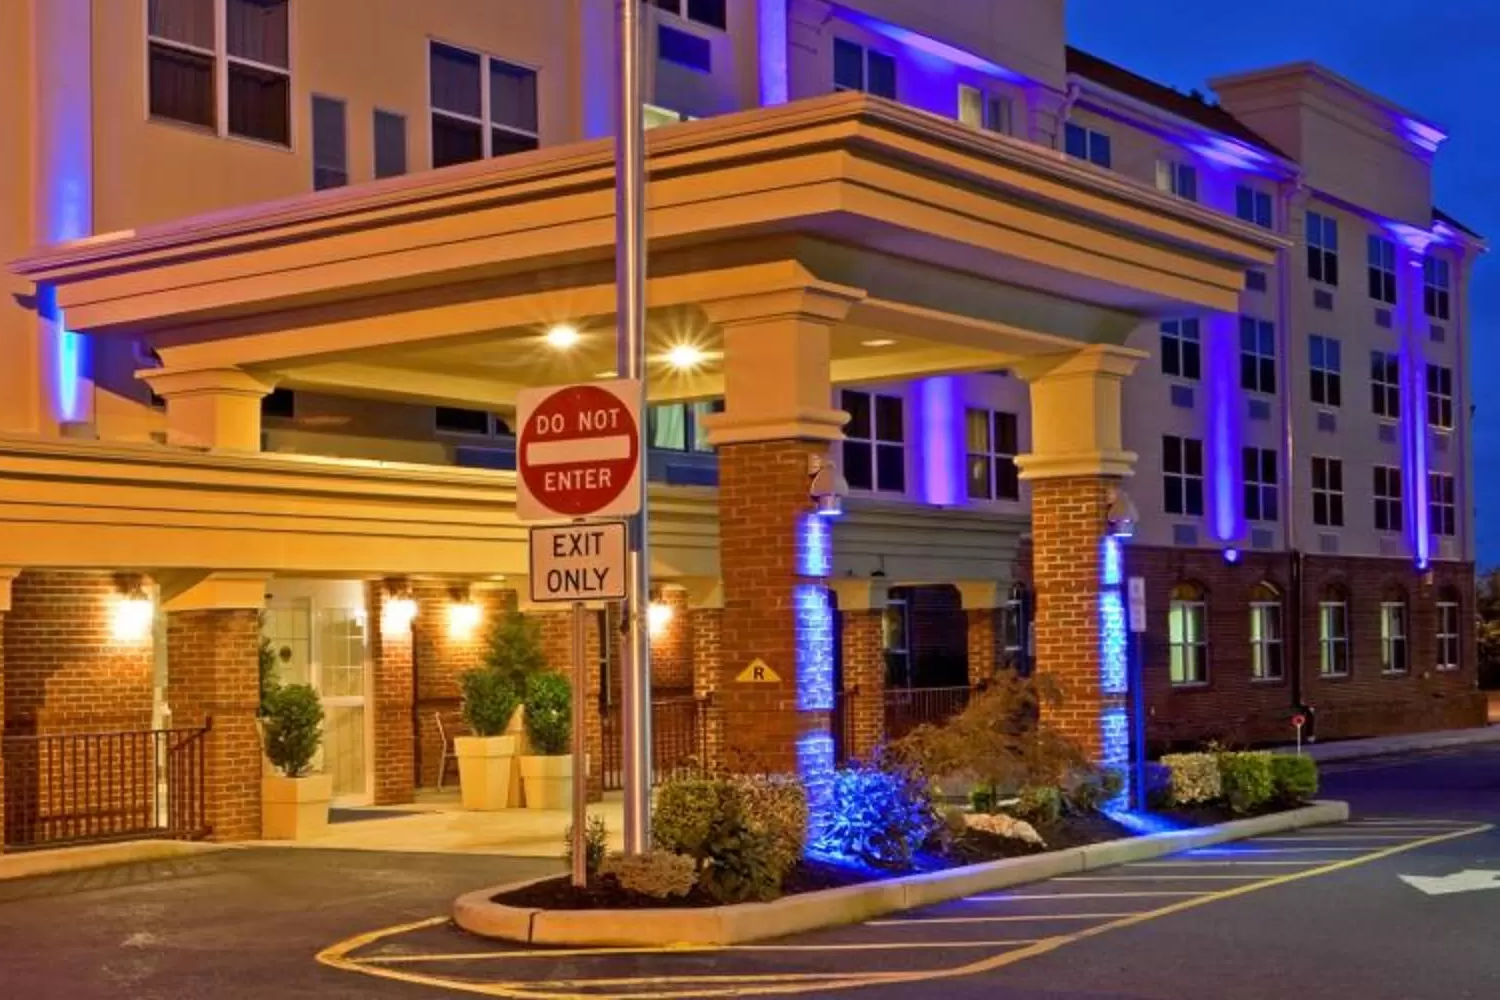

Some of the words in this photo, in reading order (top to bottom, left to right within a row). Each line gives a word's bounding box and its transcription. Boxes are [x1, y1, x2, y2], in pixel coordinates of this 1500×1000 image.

[536, 413, 565, 435] DO
[579, 408, 620, 431] NOT
[545, 468, 612, 491] ENTER
[553, 532, 604, 557] EXIT
[547, 567, 610, 593] ONLY
[753, 667, 765, 681] R
